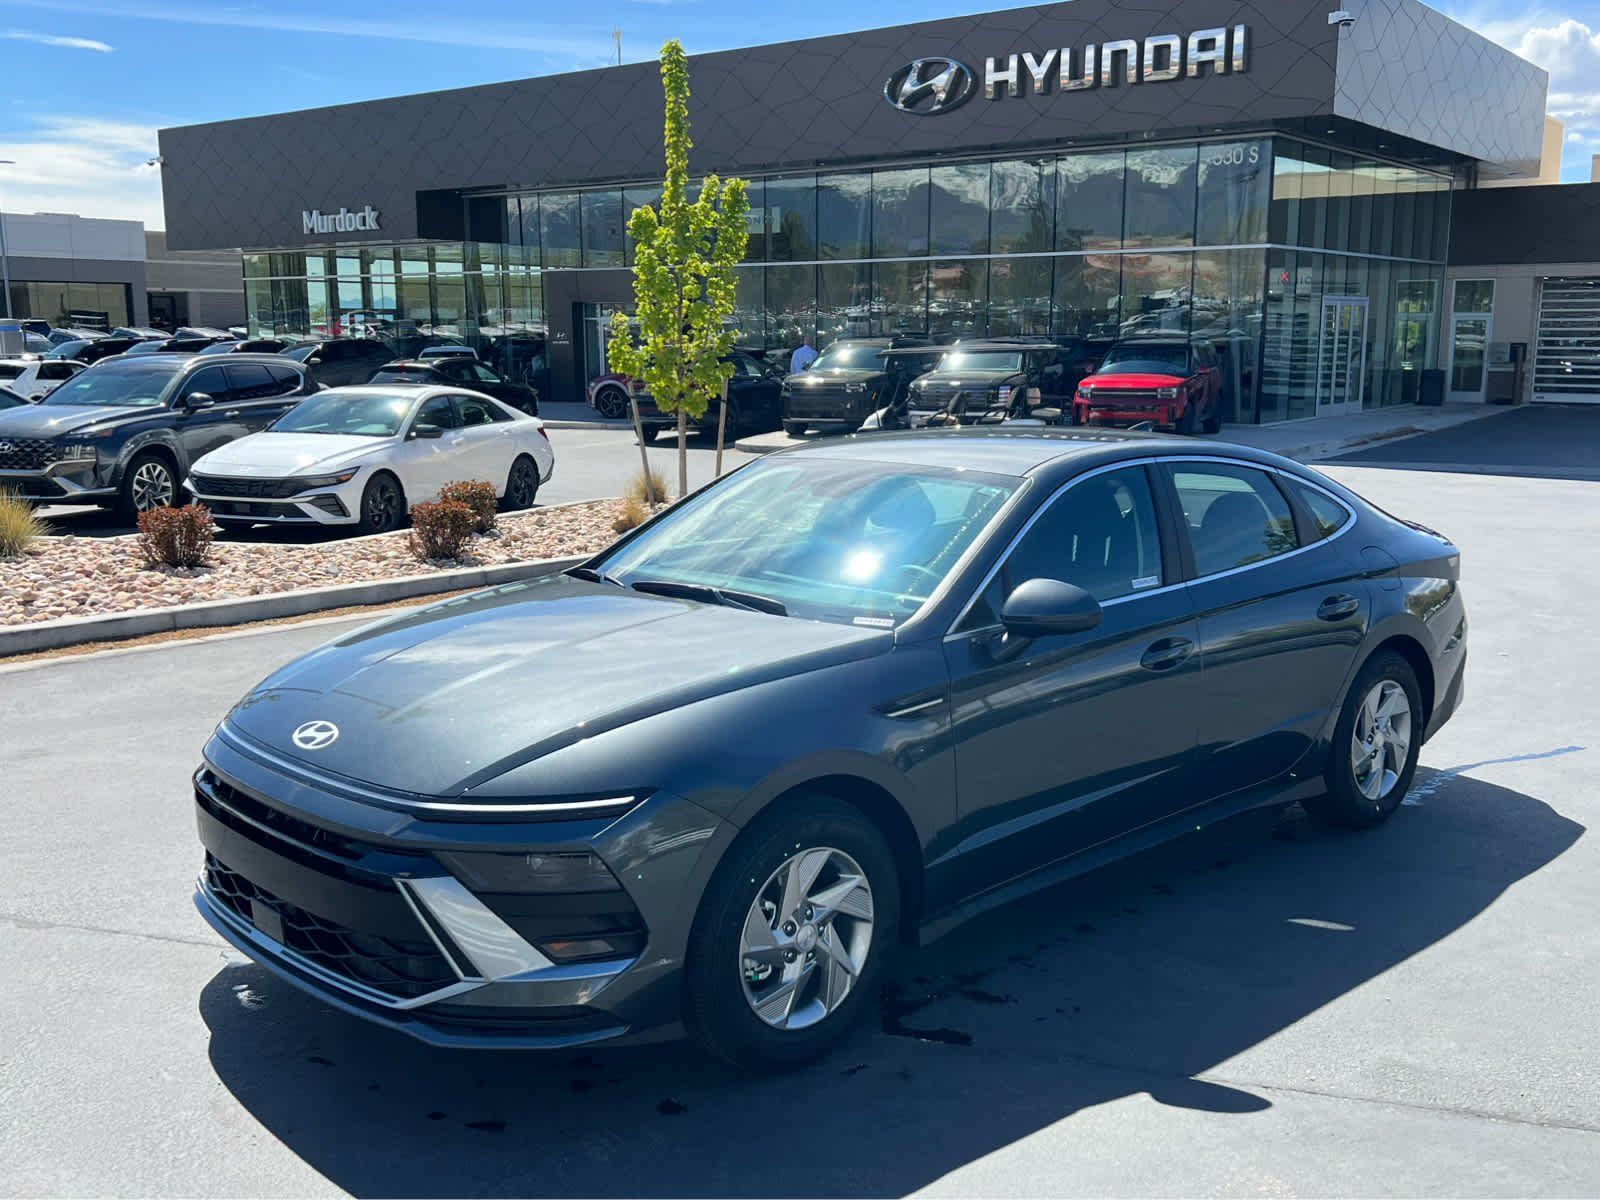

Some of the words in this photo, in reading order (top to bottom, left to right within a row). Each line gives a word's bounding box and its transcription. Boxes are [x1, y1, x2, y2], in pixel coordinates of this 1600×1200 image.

[985, 24, 1246, 100] HYUNDAI
[1248, 146, 1259, 164] S
[302, 205, 380, 234] Murdock
